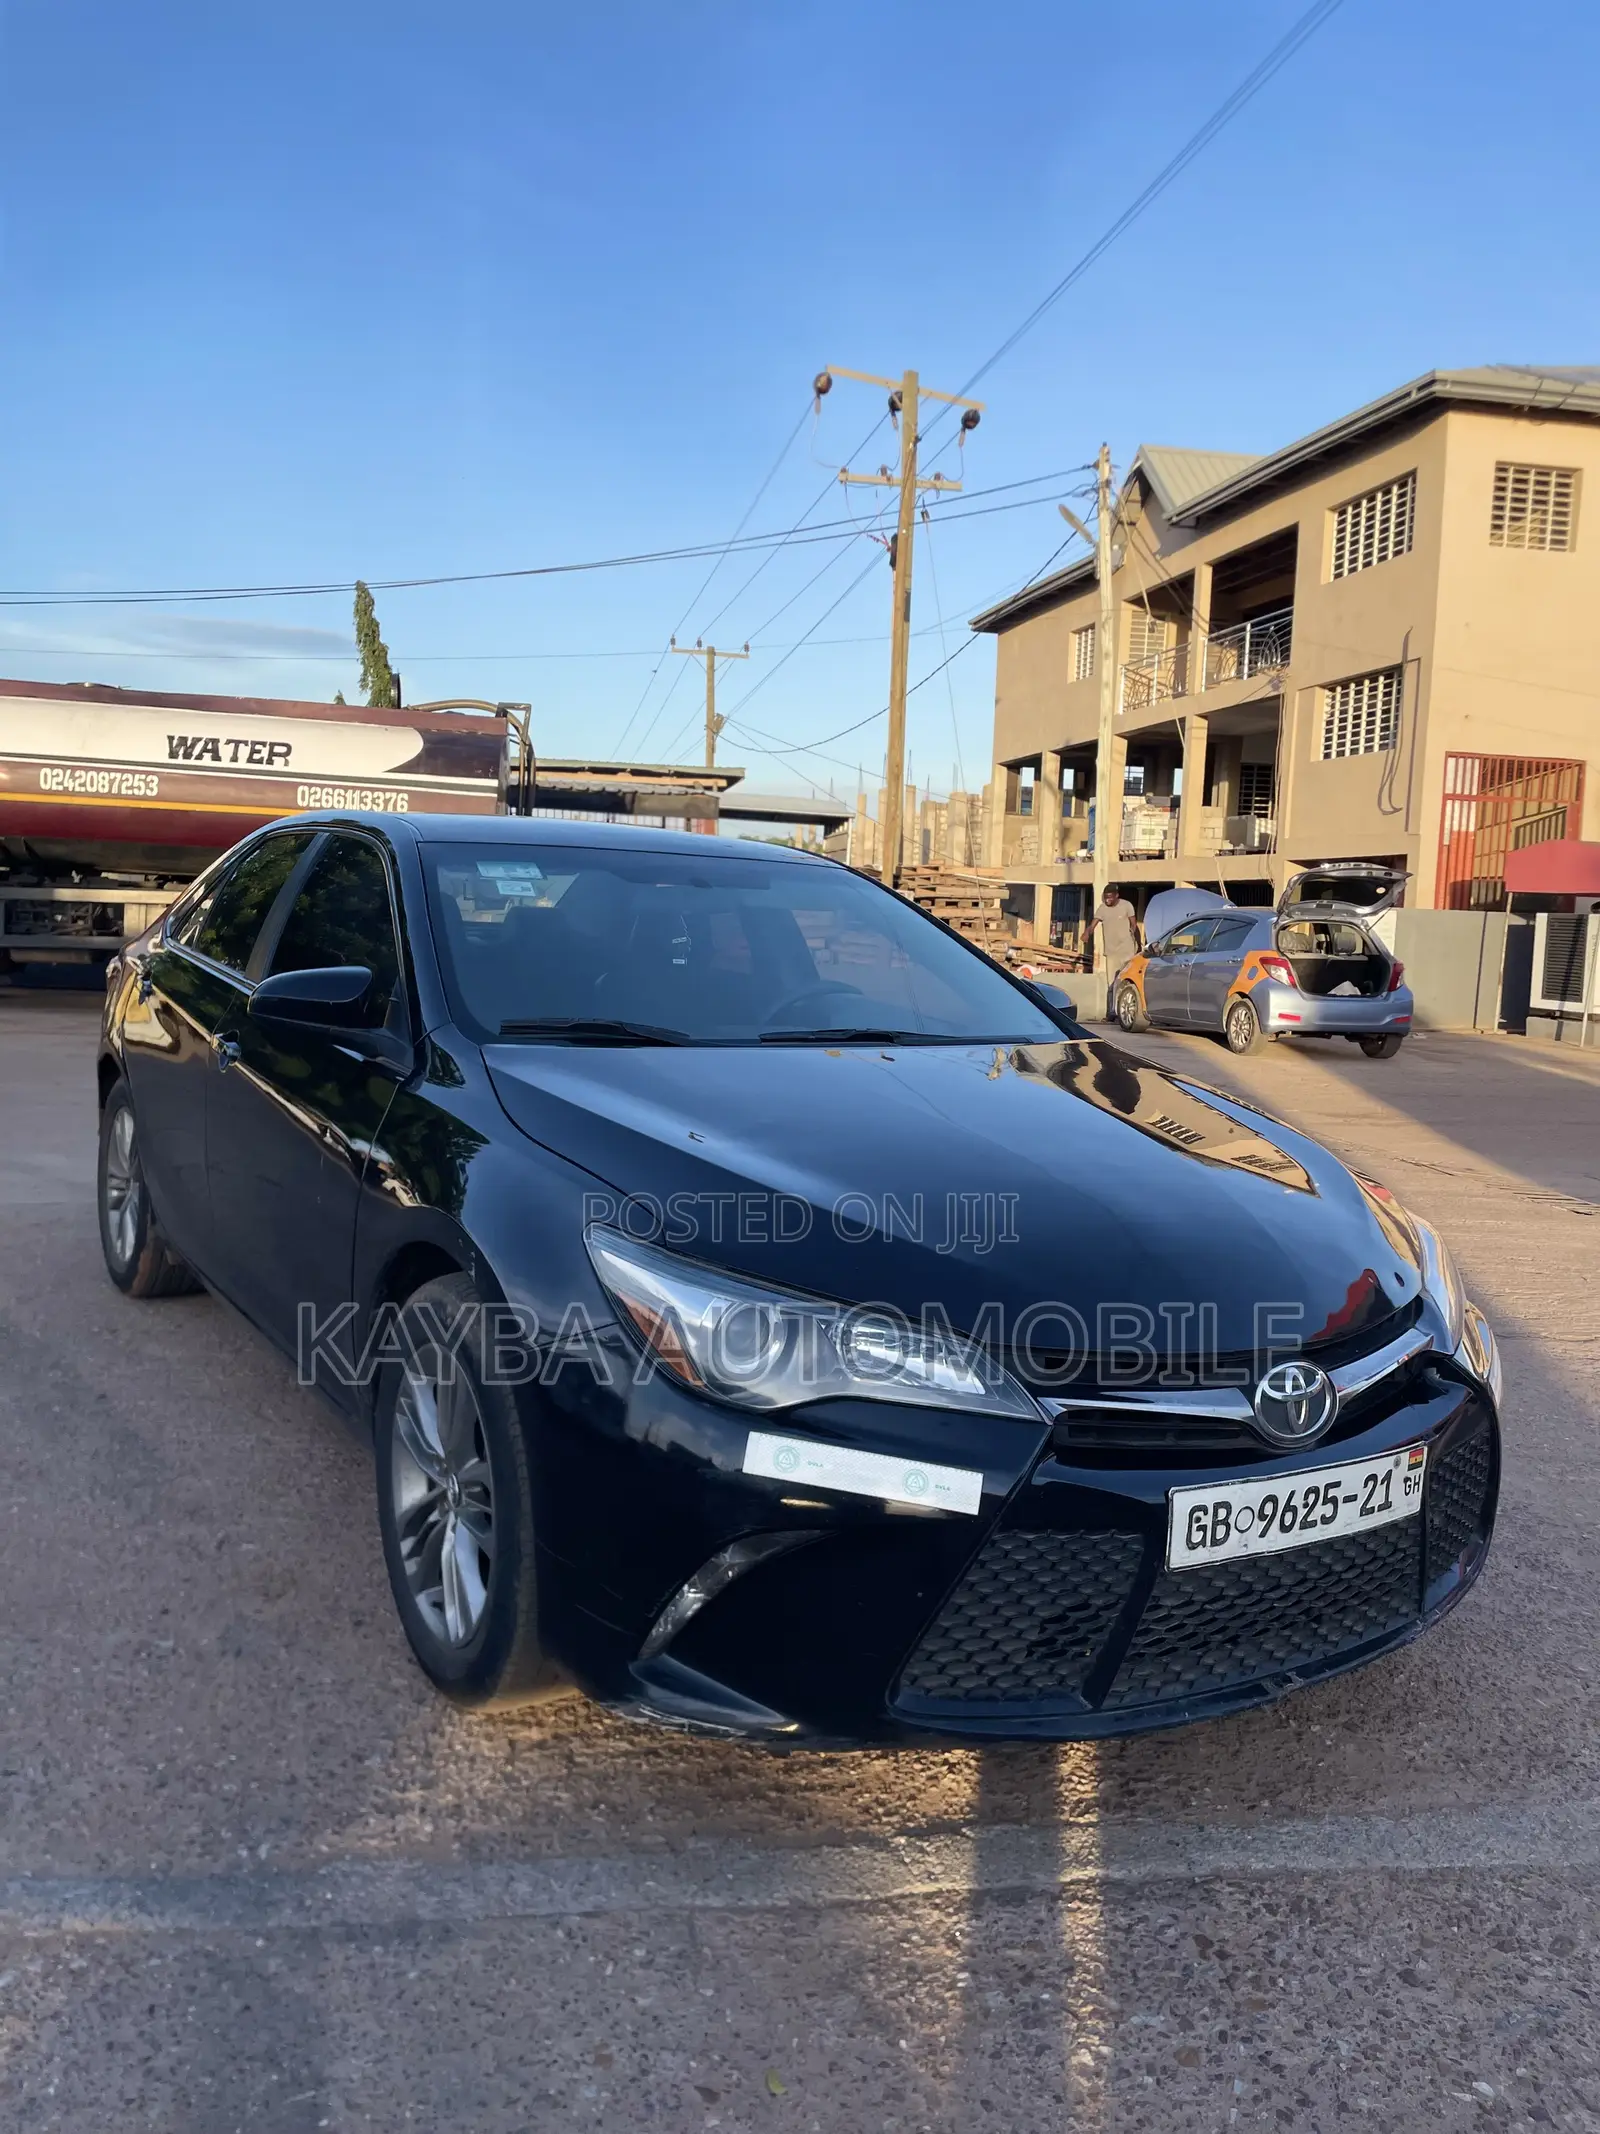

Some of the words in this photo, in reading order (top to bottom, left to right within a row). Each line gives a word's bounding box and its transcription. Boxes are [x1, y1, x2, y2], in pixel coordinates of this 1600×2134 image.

[166, 735, 292, 767] WATER
[39, 767, 159, 797] 0242087253
[296, 785, 408, 813] 0266113376
[1403, 1475, 1421, 1497] GH
[1186, 1501, 1232, 1550] GB
[1257, 1468, 1394, 1539] 9625-21
